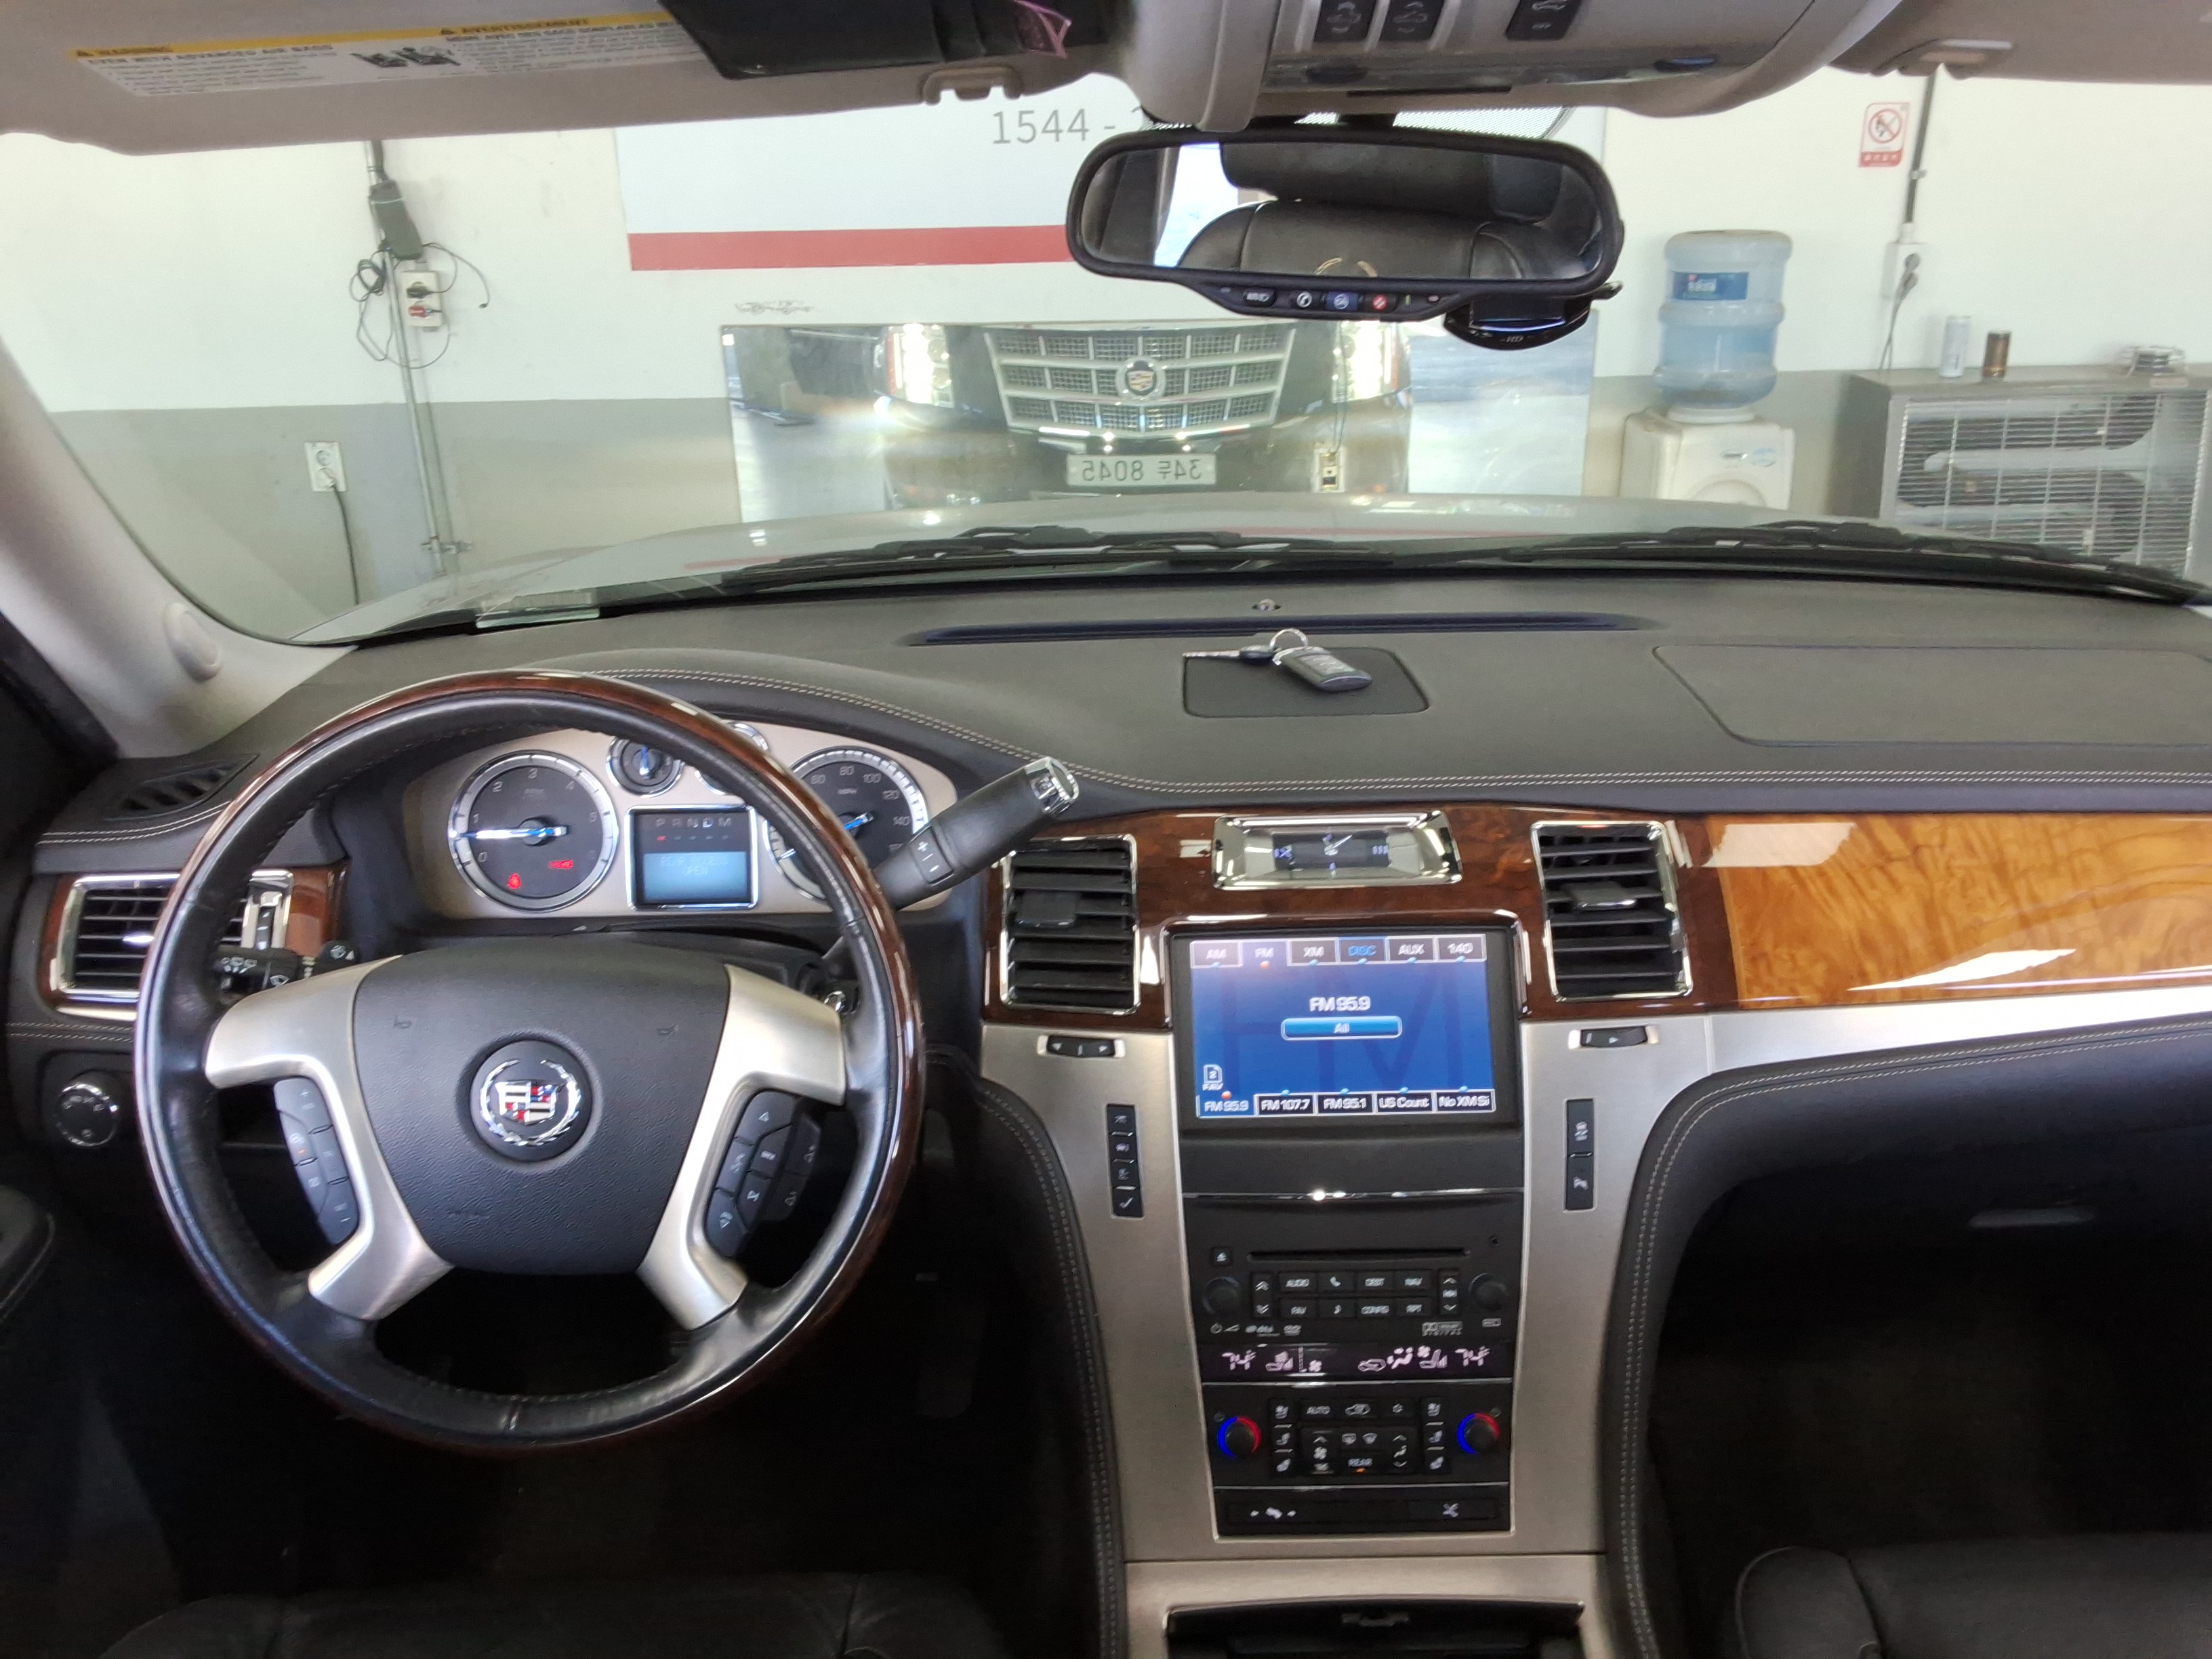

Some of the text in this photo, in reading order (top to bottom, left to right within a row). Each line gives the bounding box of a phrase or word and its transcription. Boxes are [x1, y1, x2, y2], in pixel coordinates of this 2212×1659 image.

[992, 108, 1090, 144] 1544
[527, 767, 538, 779] 3
[862, 772, 882, 783] 100
[491, 781, 503, 792] 2
[565, 781, 575, 791] 4
[472, 813, 480, 823] 1
[893, 815, 911, 826] 140
[478, 851, 488, 863] 0
[1206, 948, 1227, 960] AM
[1254, 947, 1274, 958] FM
[1303, 945, 1324, 958] XM
[1348, 944, 1377, 957] DISC
[1397, 943, 1426, 956] AUX
[1309, 996, 1335, 1012] FM
[1209, 1069, 1217, 1080] 2
[1202, 1082, 1224, 1091] FAV
[1204, 1101, 1223, 1112] FM
[1261, 1099, 1310, 1111] FM 107.7
[1324, 1098, 1343, 1109] FM
[1378, 1097, 1396, 1108] US
[1439, 1096, 1456, 1107] No
[1456, 1095, 1477, 1107] XM
